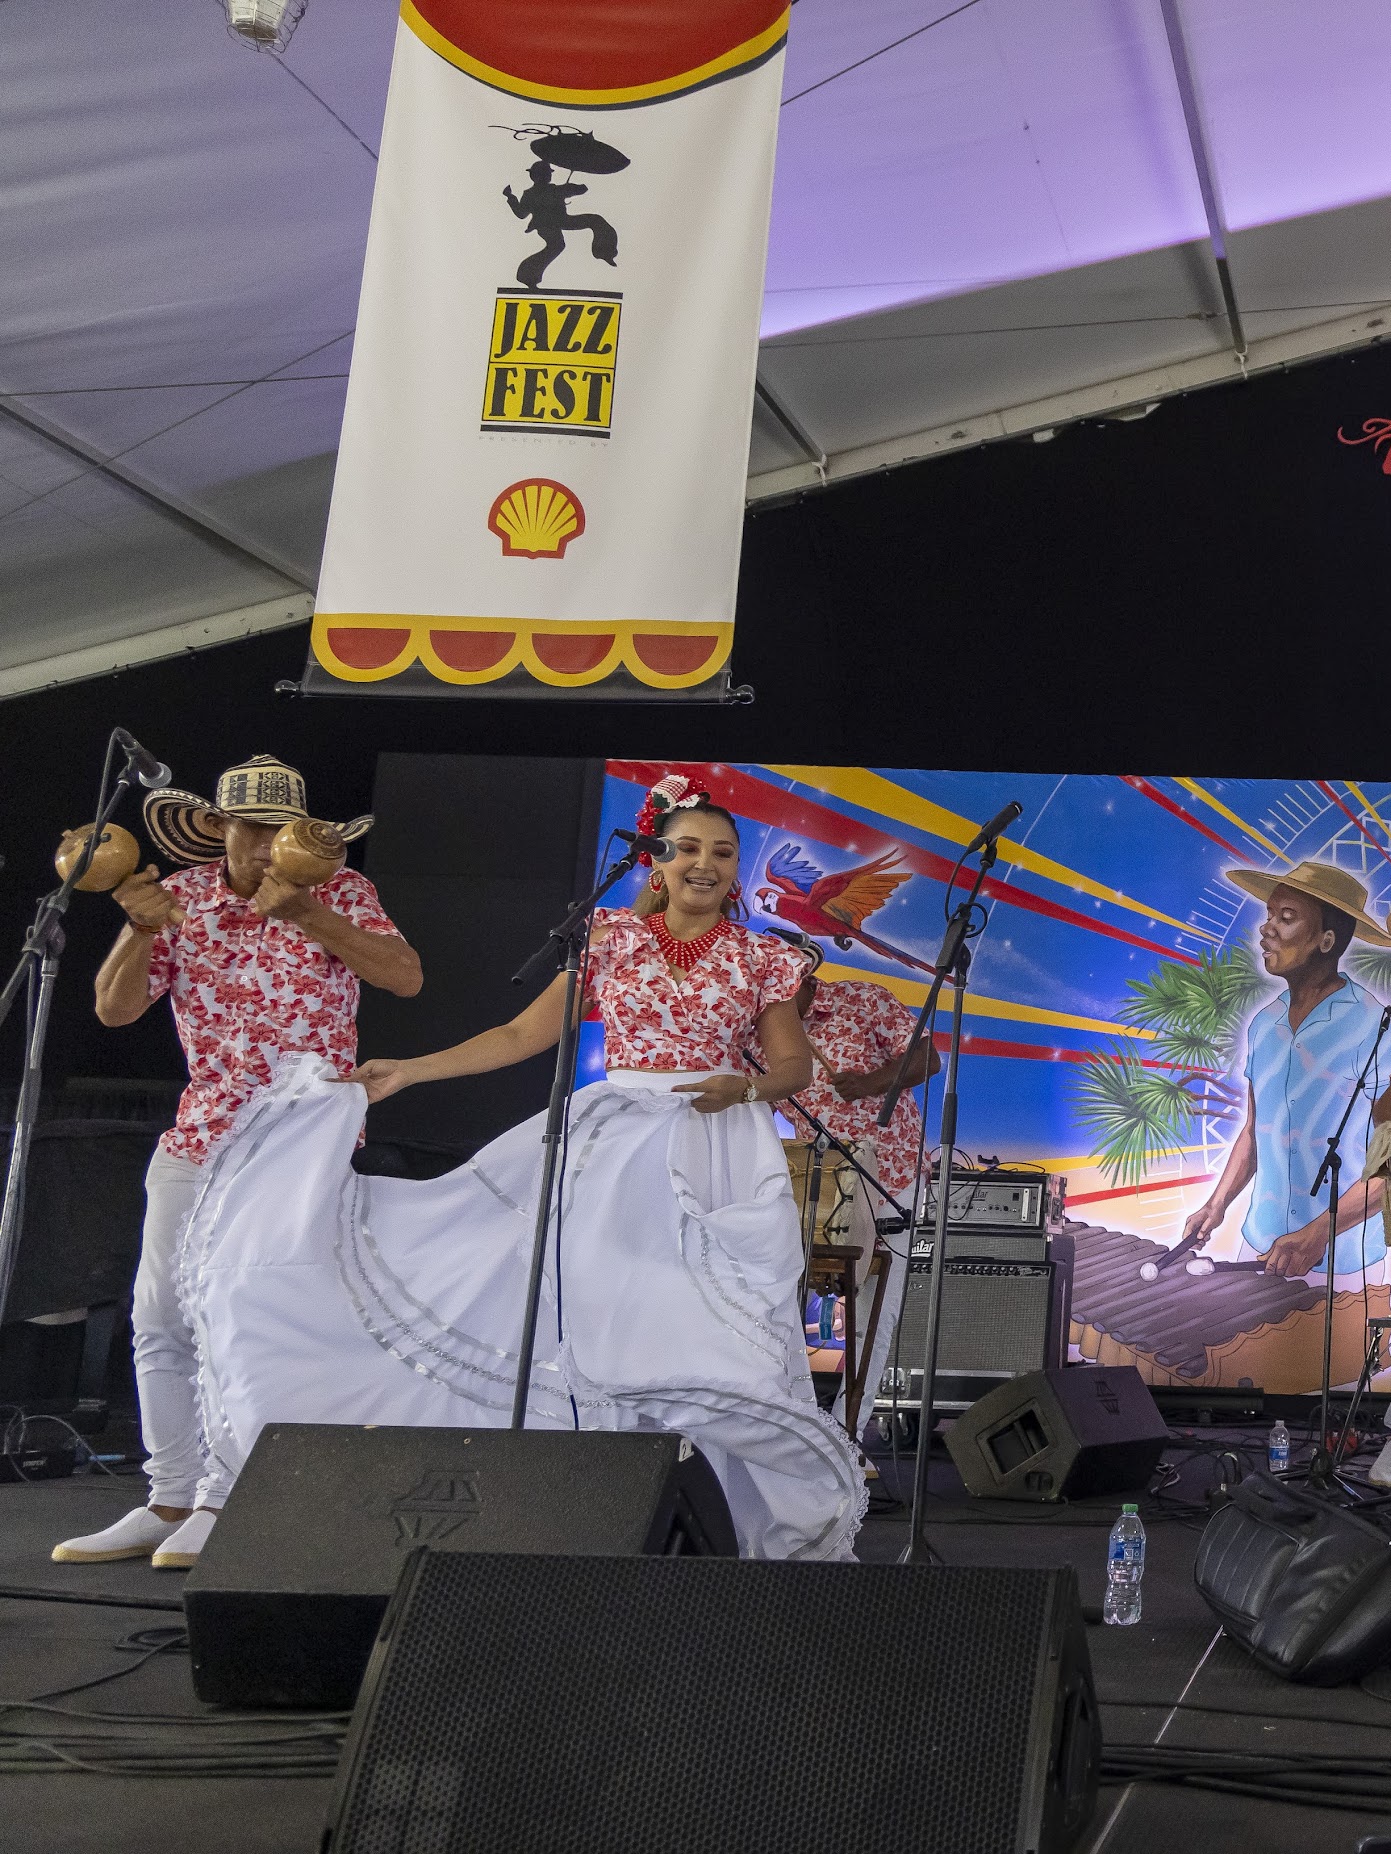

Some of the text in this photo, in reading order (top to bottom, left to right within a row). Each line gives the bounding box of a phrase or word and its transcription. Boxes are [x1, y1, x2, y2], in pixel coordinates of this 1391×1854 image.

[494, 302, 615, 358] JAZZ
[489, 367, 611, 422] FEST
[478, 436, 576, 446] PRESENTED
